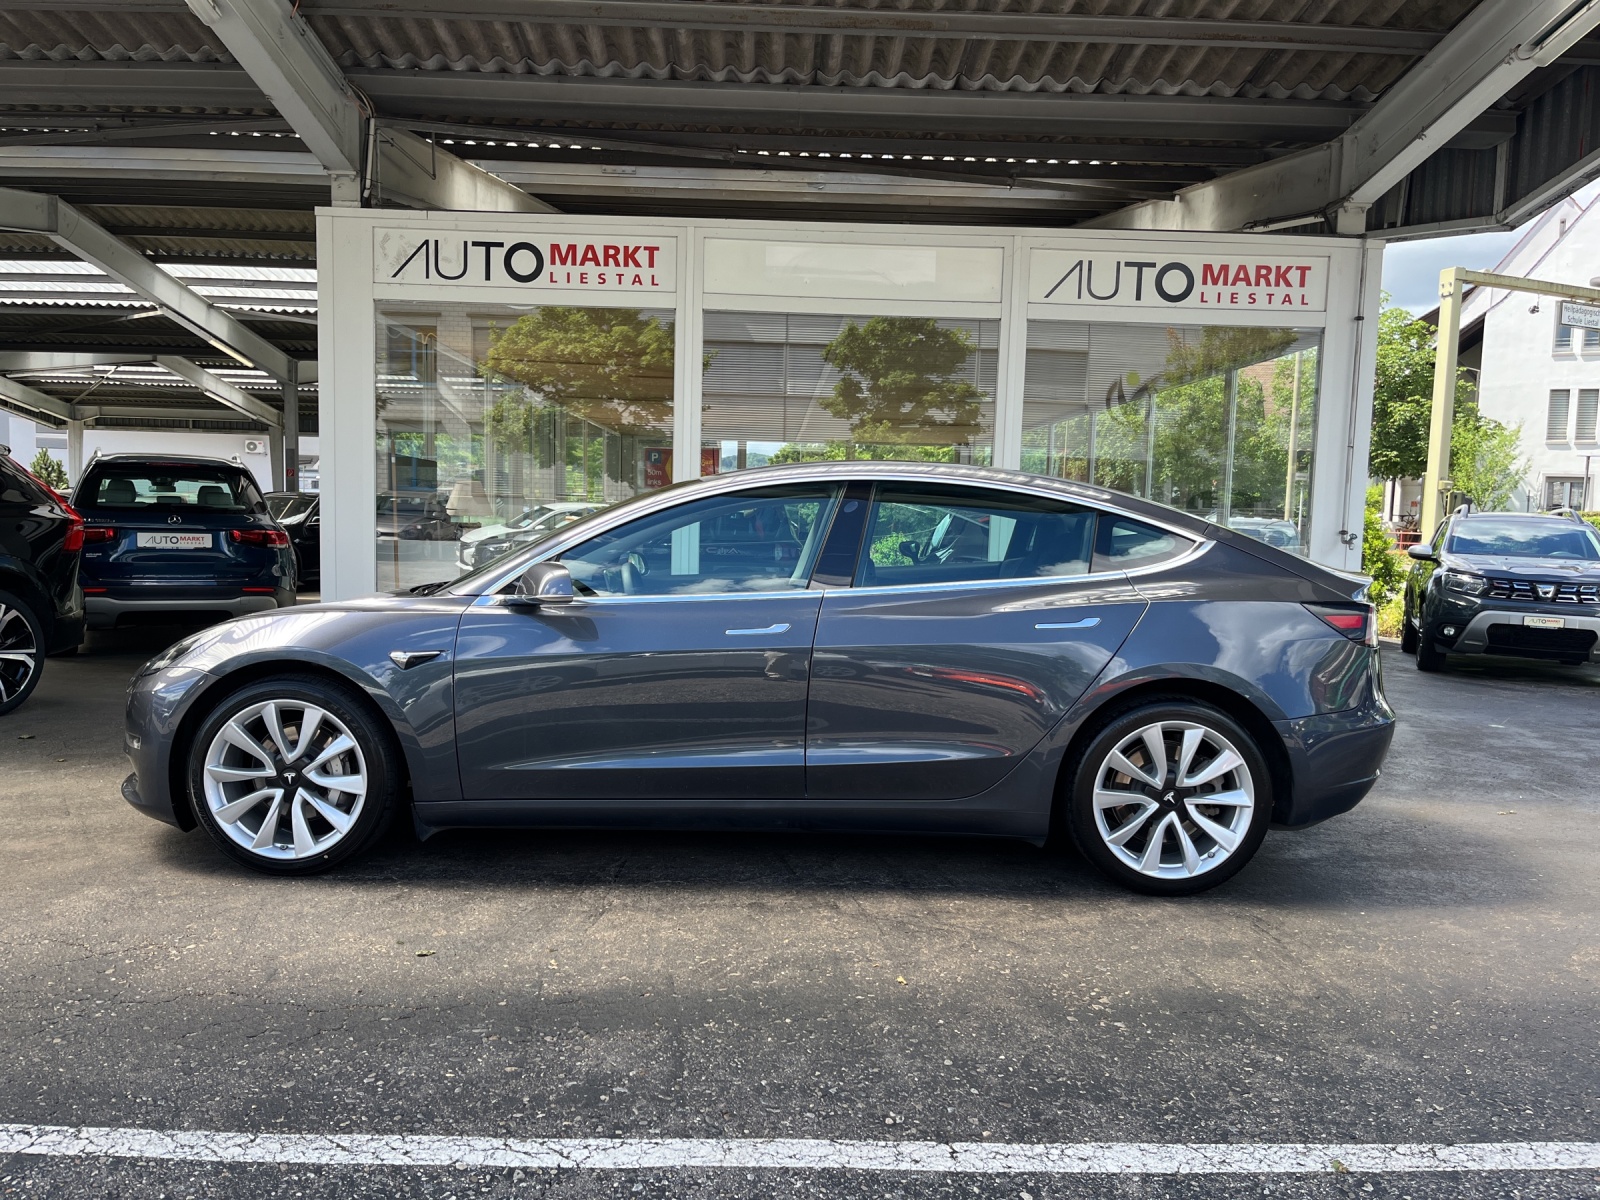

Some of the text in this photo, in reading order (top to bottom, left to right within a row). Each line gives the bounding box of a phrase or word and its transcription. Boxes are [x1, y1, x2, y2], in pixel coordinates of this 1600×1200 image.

[391, 239, 660, 283] AUTO MARKT
[549, 271, 660, 286] LIESTAL
[1043, 259, 1312, 303] AUTO MARKT
[1200, 291, 1309, 306] LIESTAL
[651, 452, 659, 462] P
[647, 478, 662, 486] links
[145, 535, 179, 545] AUTO
